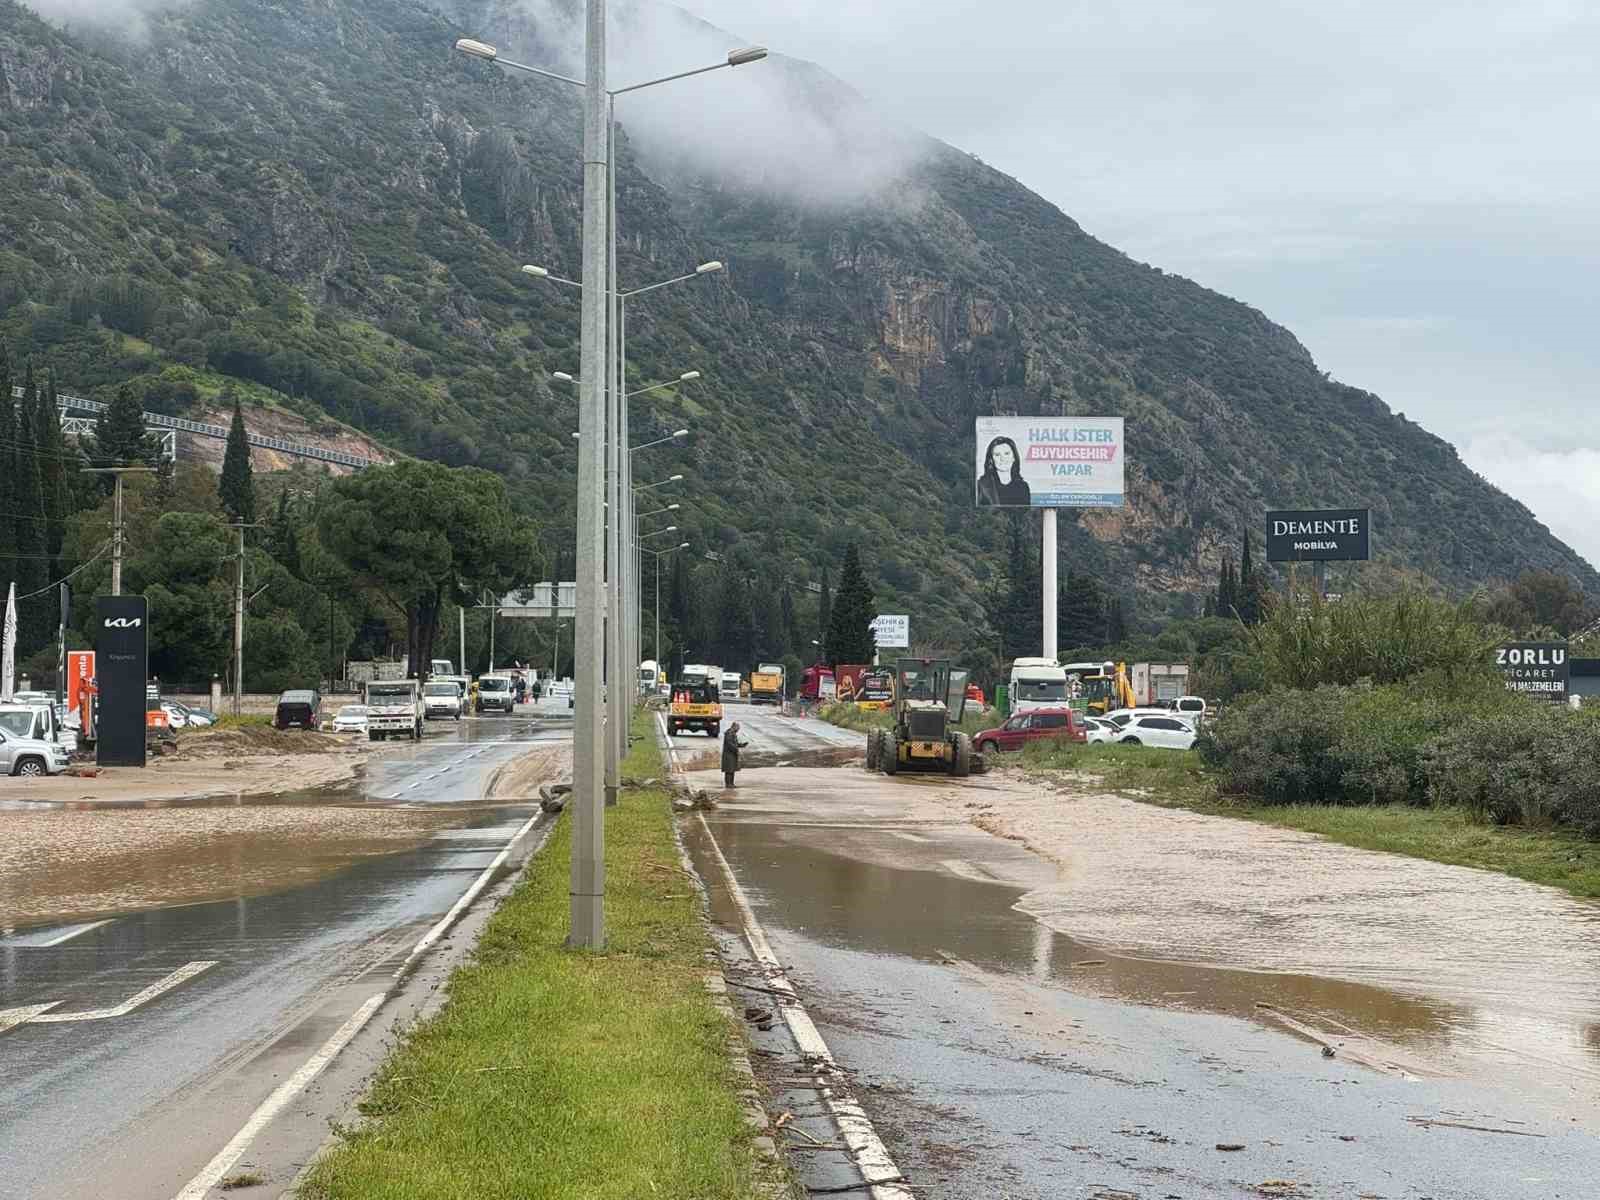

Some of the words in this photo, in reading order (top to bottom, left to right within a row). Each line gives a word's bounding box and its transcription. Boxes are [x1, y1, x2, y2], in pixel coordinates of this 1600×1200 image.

[1028, 428, 1069, 442] HALK
[1050, 463, 1093, 475] YAPAR
[1273, 519, 1359, 536] DEMENTE
[104, 618, 141, 628] KIA
[1496, 649, 1565, 665] ZORLU
